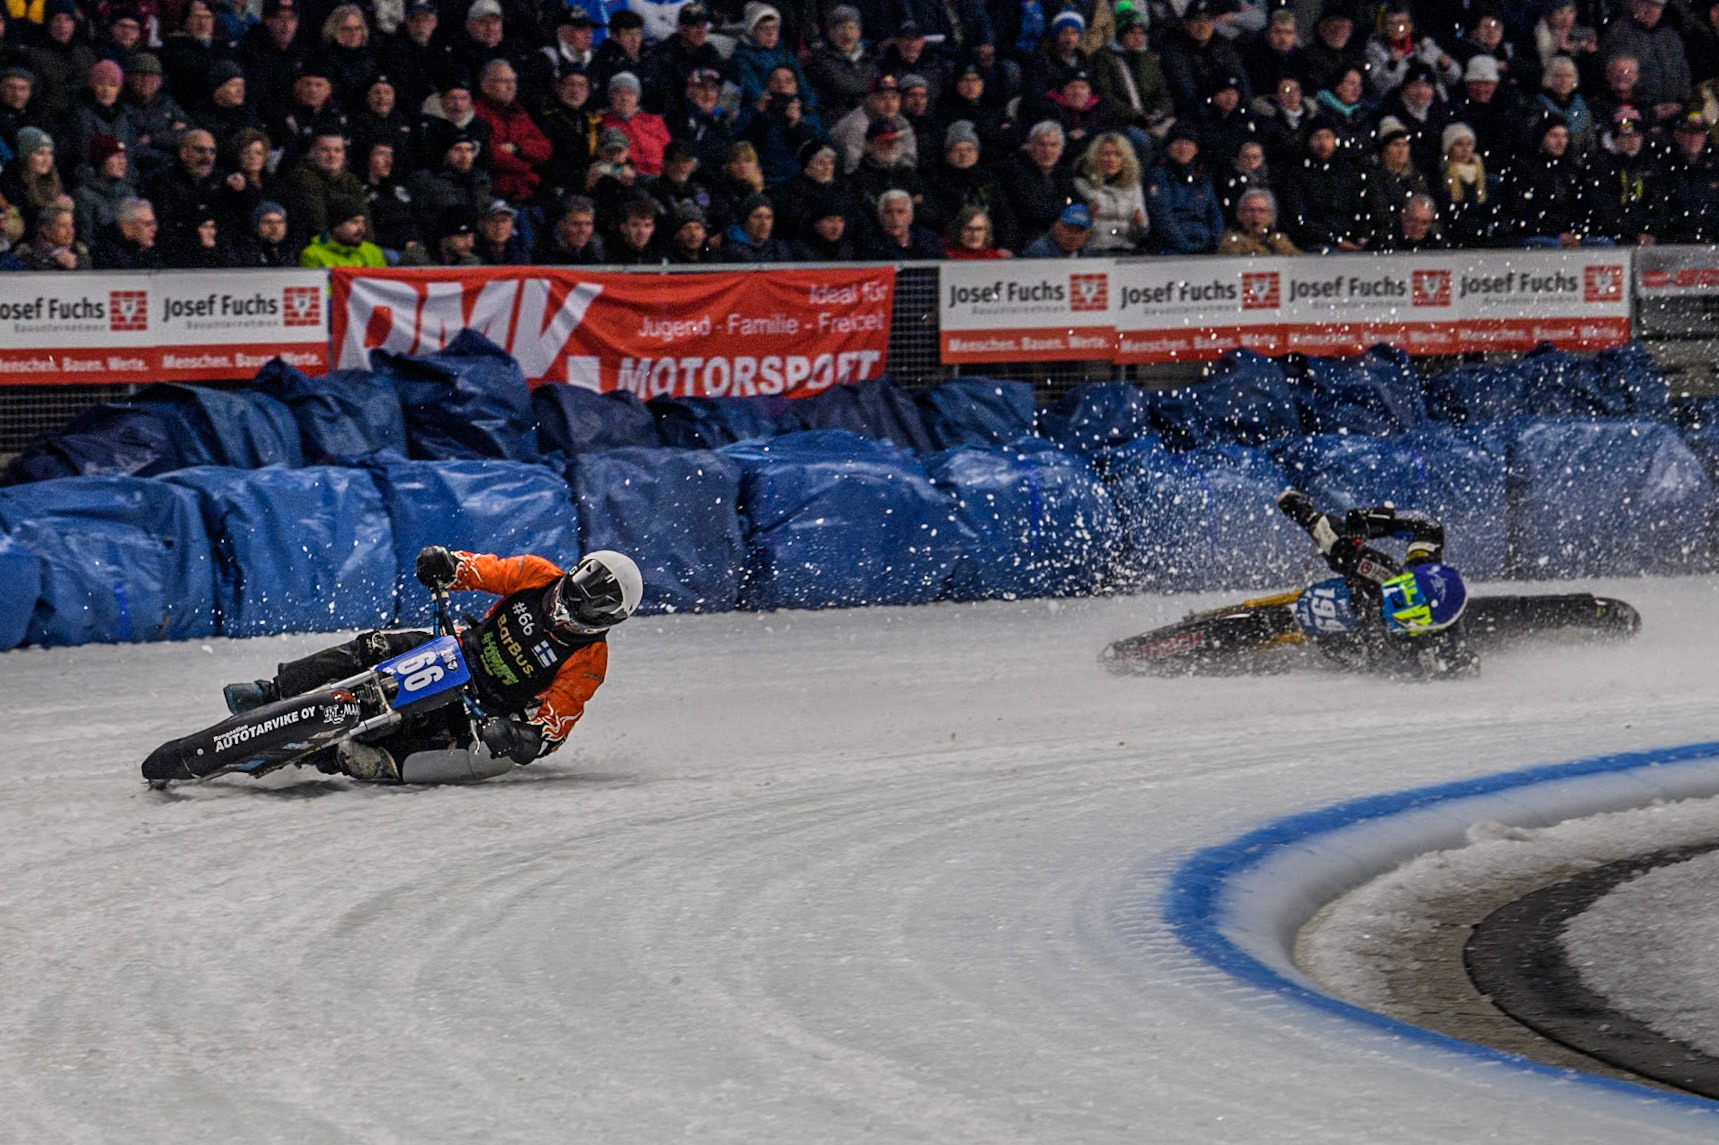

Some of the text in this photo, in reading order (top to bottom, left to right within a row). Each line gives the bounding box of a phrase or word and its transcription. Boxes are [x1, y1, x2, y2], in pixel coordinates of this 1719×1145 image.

[949, 281, 1065, 308] Josef Fuchs
[1120, 280, 1237, 309] Josef Fuchs
[1289, 275, 1406, 302] Josef Fuchs
[1459, 271, 1578, 298] Josef Fuchs
[49, 297, 105, 319] Fuchs
[163, 294, 278, 322] Josef Fuchs
[639, 315, 711, 342] Jugend
[727, 313, 799, 335] Familie
[512, 602, 535, 636] #66
[497, 613, 534, 675] BarBus
[396, 651, 444, 691] 66
[215, 711, 299, 753] AUTOTARVIKE
[300, 705, 316, 720] OY
